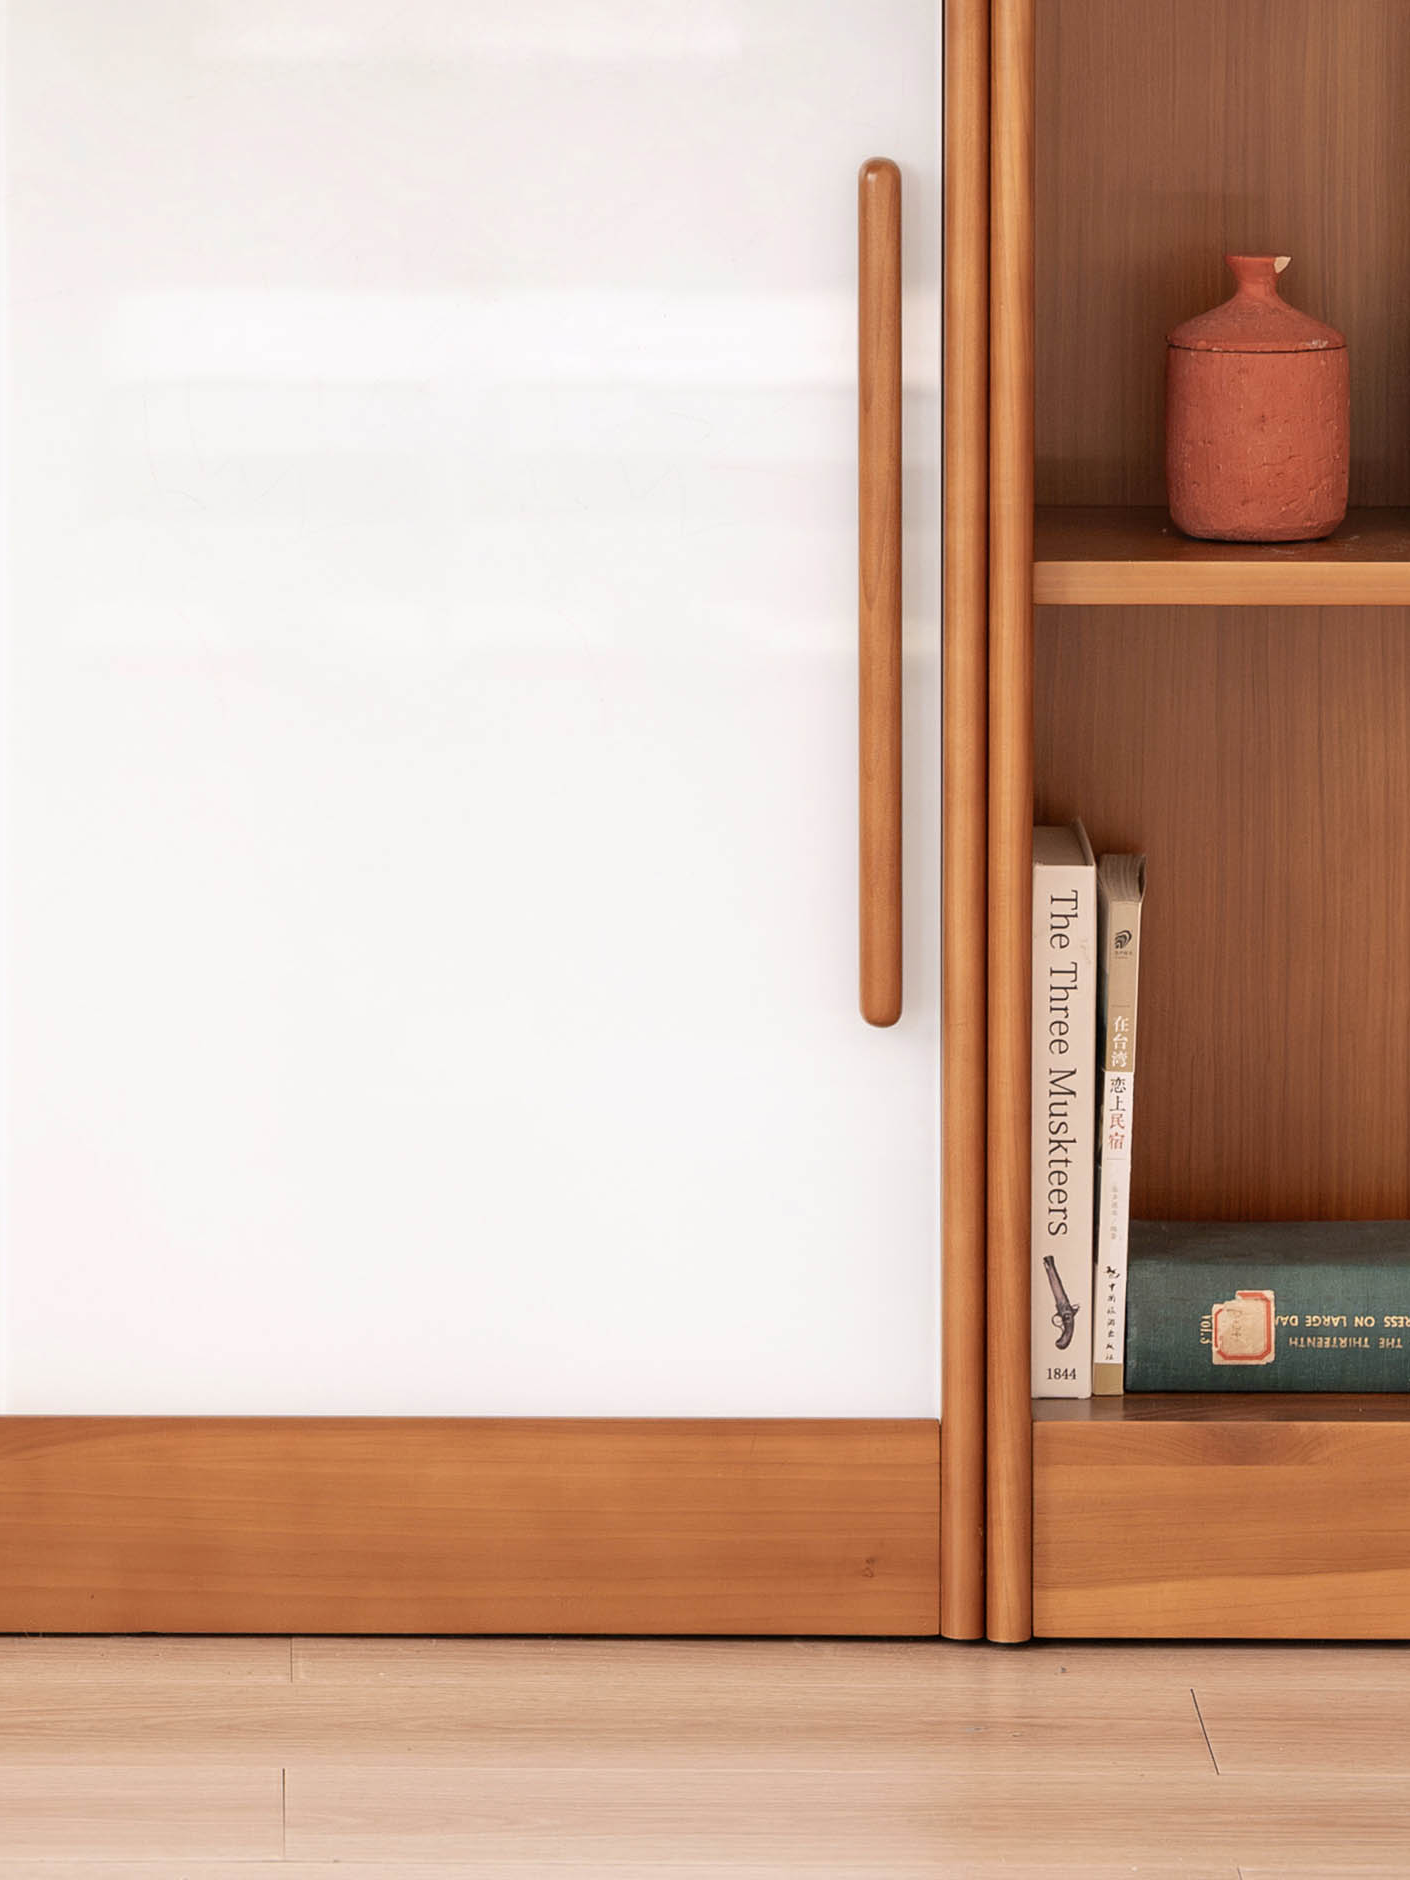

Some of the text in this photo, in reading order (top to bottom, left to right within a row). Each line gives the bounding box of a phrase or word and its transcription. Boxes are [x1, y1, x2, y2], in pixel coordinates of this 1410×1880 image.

[1046, 889, 1079, 1237] The Three Musketeers
[1107, 1016, 1130, 1150] 在台湾 恋上民宿
[1305, 1315, 1347, 1328] LARGE
[1354, 1316, 1375, 1328] ON
[1288, 1336, 1403, 1349] THE THIRTEENTH
[1046, 1367, 1077, 1380] 1844
